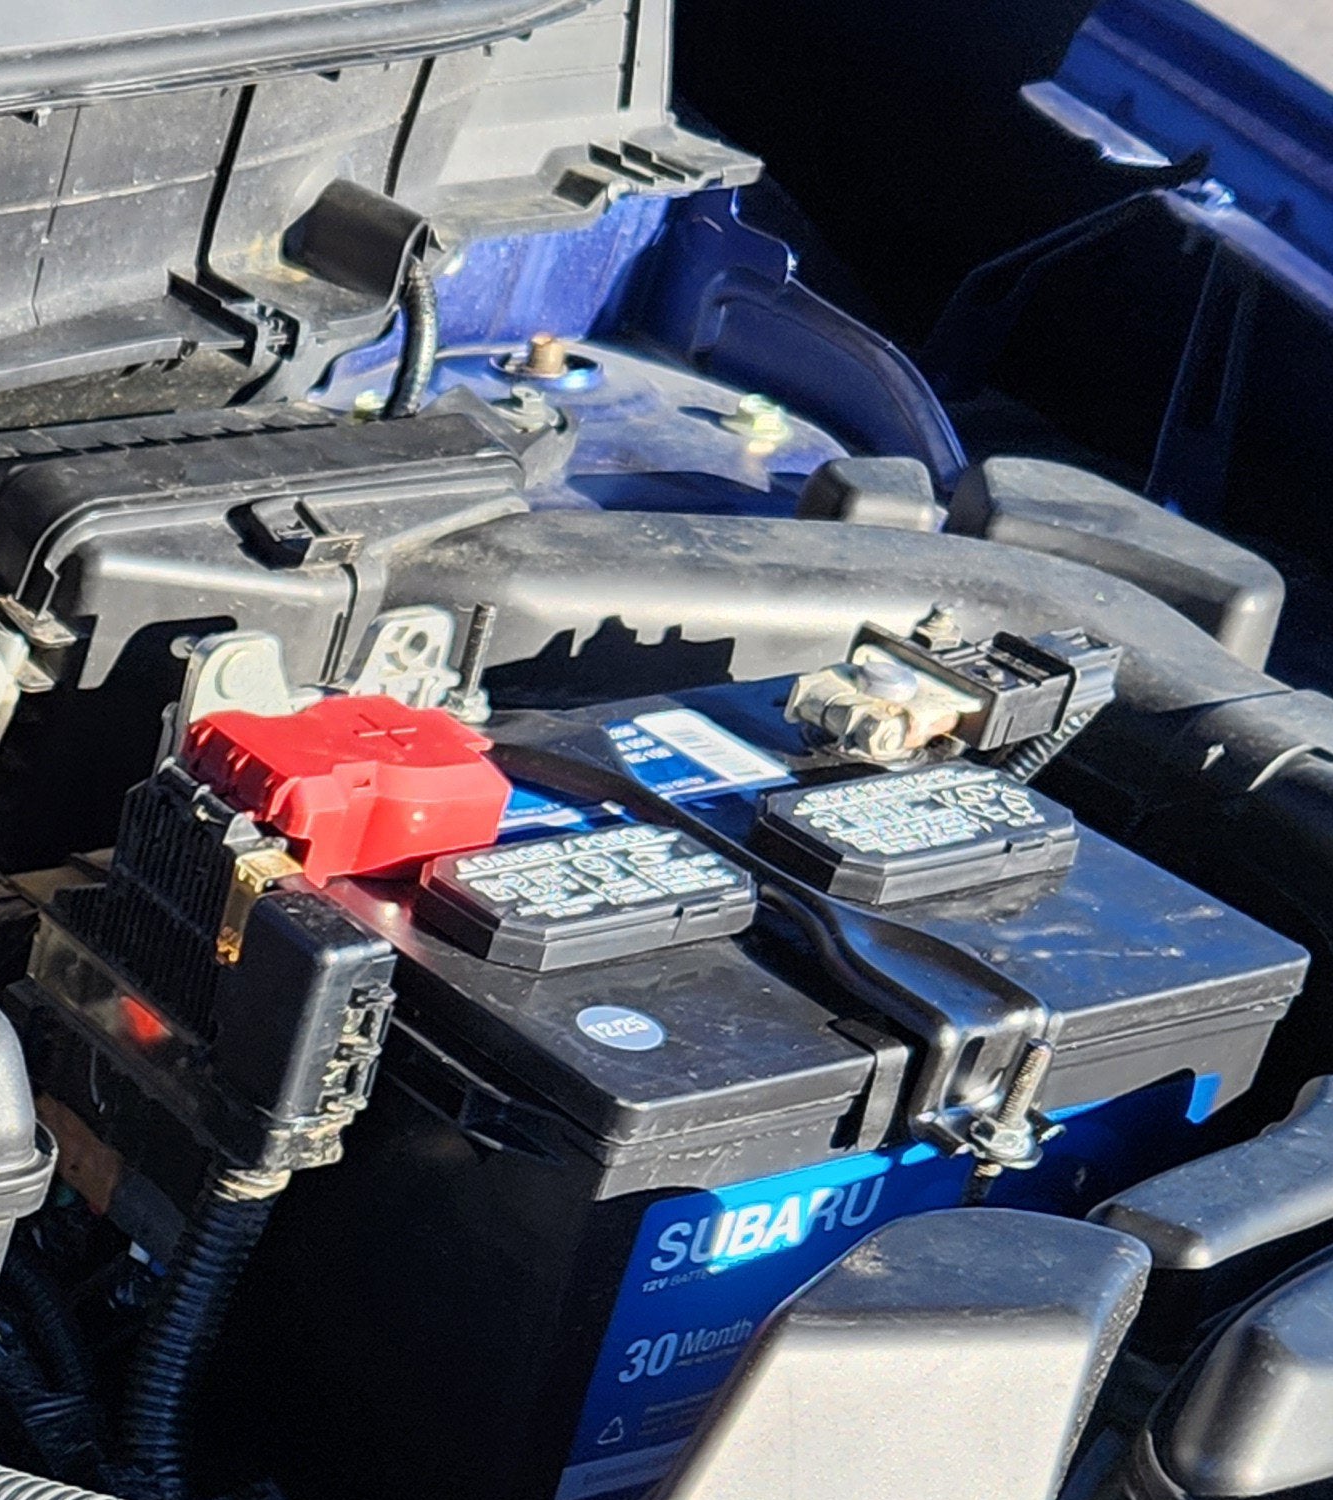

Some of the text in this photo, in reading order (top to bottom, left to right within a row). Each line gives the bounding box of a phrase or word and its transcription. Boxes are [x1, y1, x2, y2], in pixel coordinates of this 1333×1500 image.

[471, 842, 563, 869] DANGER
[575, 825, 660, 850] POISON
[586, 1015, 650, 1039] 12/25
[650, 1176, 885, 1272] SUBARU
[642, 1277, 669, 1292] 12V
[618, 1332, 678, 1383] 30
[679, 1318, 754, 1357] Month
